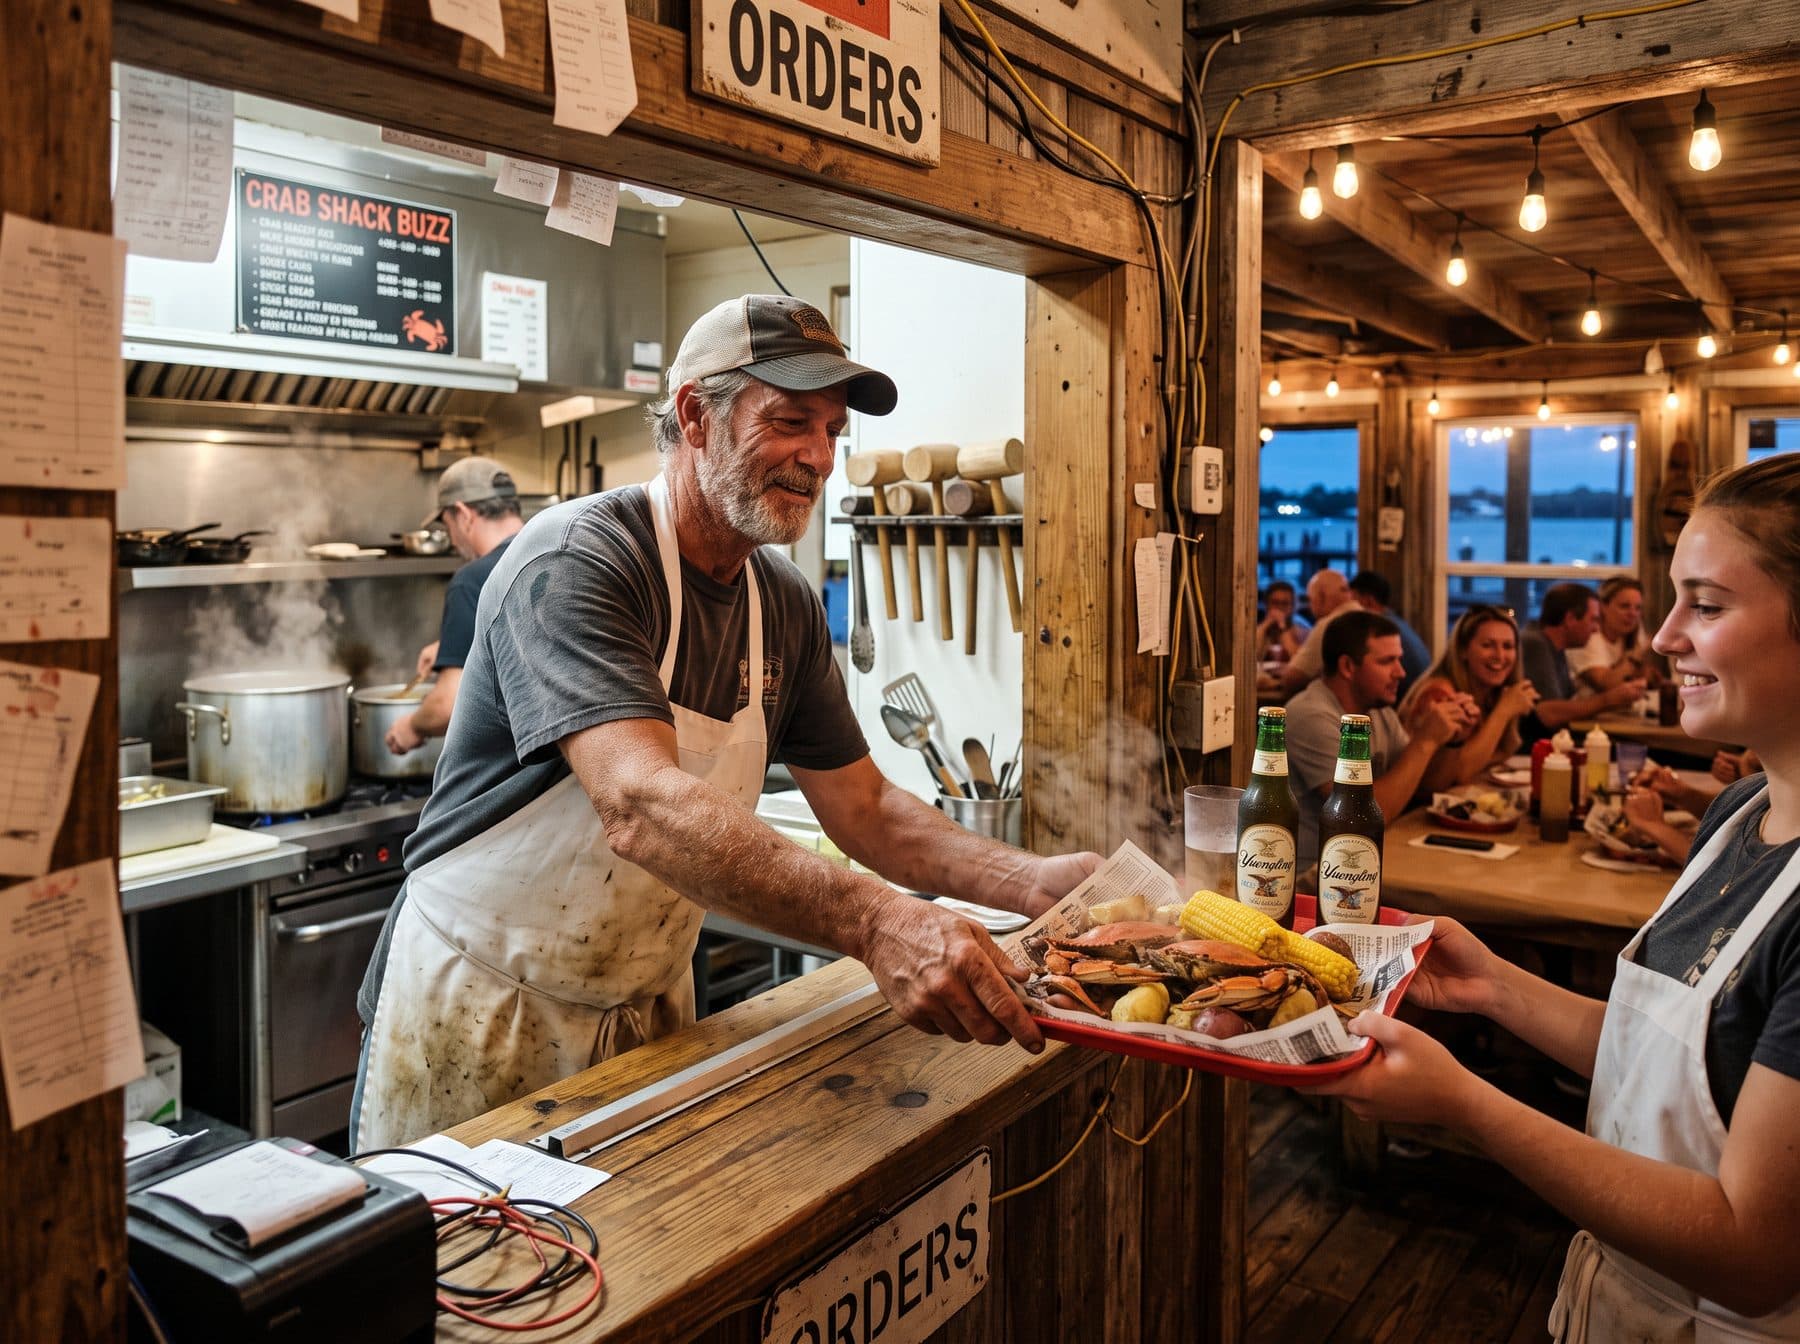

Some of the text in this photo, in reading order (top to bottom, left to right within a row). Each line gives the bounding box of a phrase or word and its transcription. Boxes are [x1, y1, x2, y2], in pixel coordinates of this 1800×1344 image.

[729, 0, 923, 144] ORDERS
[246, 179, 311, 217] CRAB
[317, 192, 392, 233] SHACK
[397, 208, 451, 243] BUZZ
[1240, 849, 1294, 873] Yuengling
[1321, 861, 1378, 885] Yuengling
